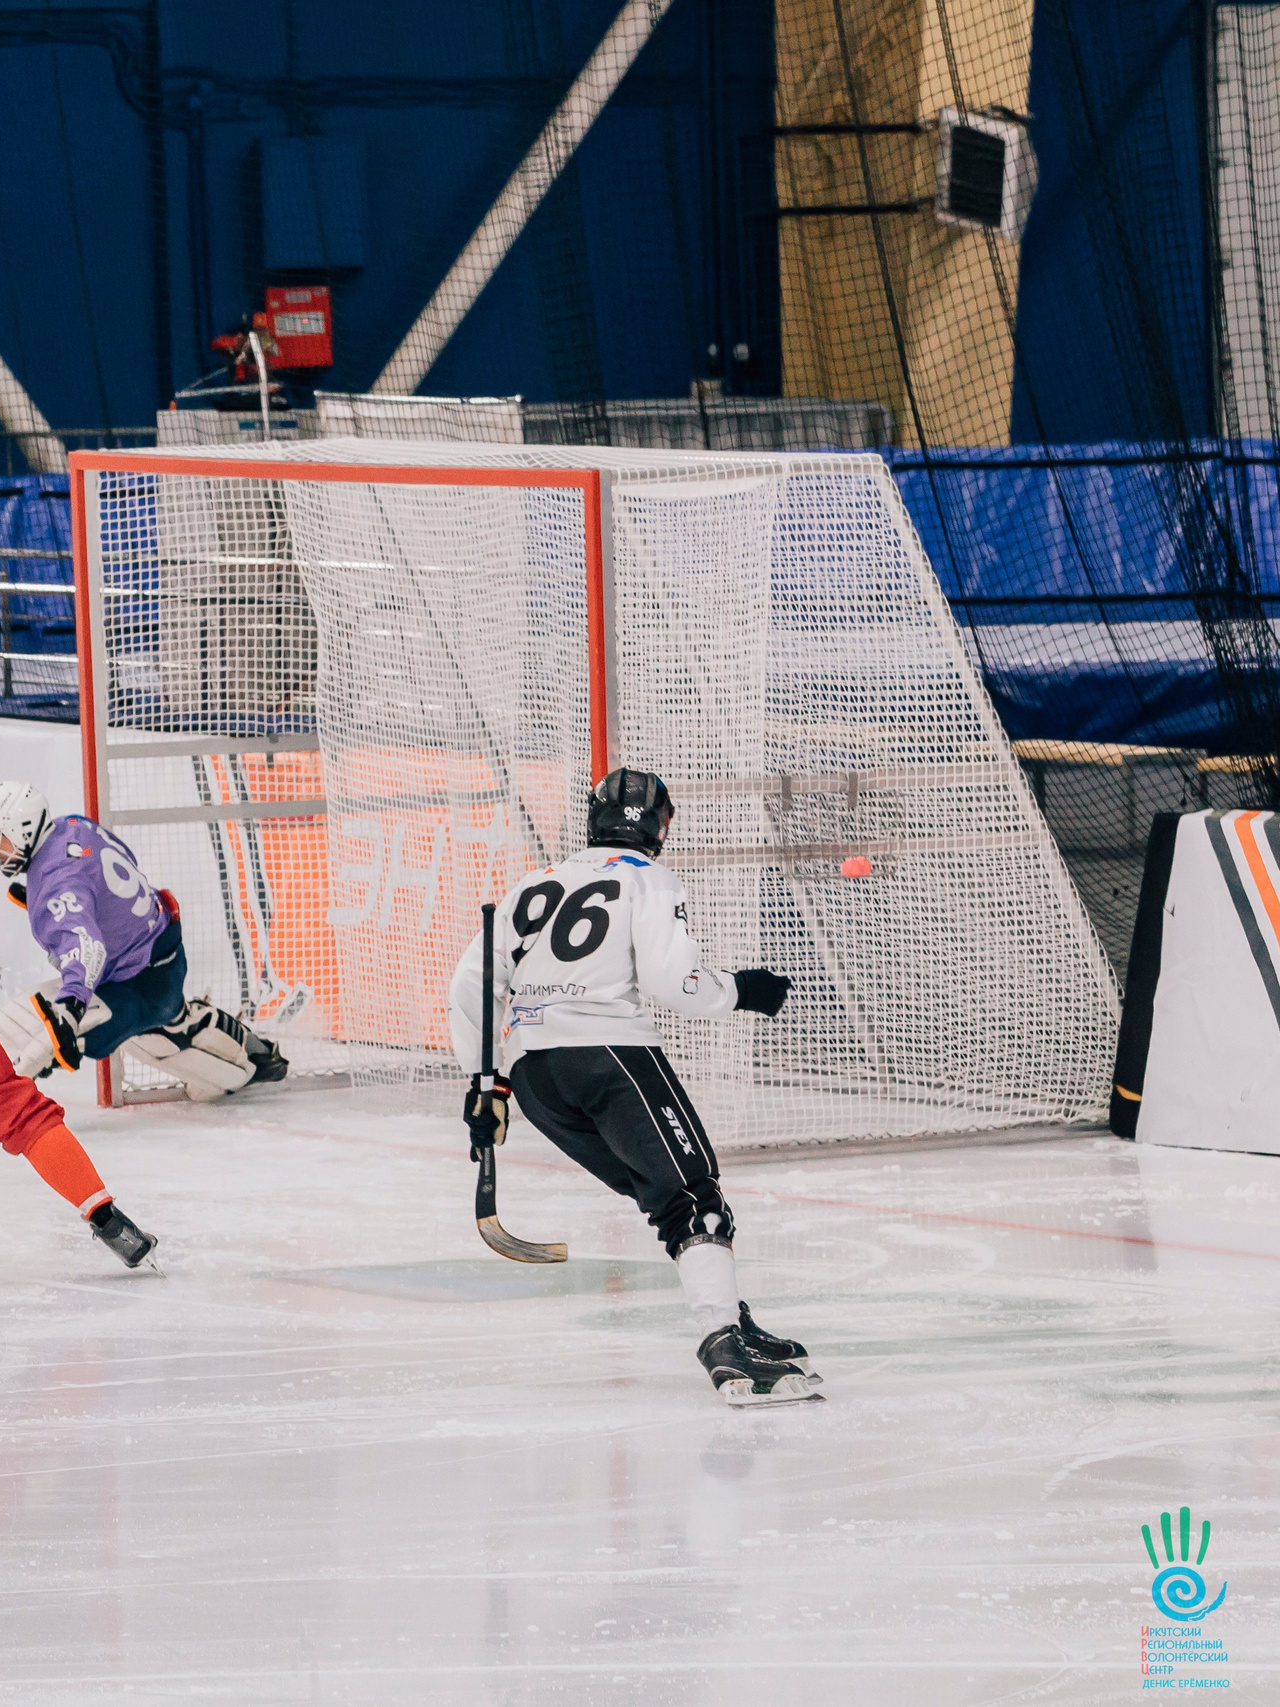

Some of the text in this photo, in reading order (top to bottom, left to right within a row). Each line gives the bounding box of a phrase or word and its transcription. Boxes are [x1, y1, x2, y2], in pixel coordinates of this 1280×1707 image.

[624, 806, 642, 822] 96
[511, 879, 621, 963] 96
[661, 1106, 696, 1156] STEX
